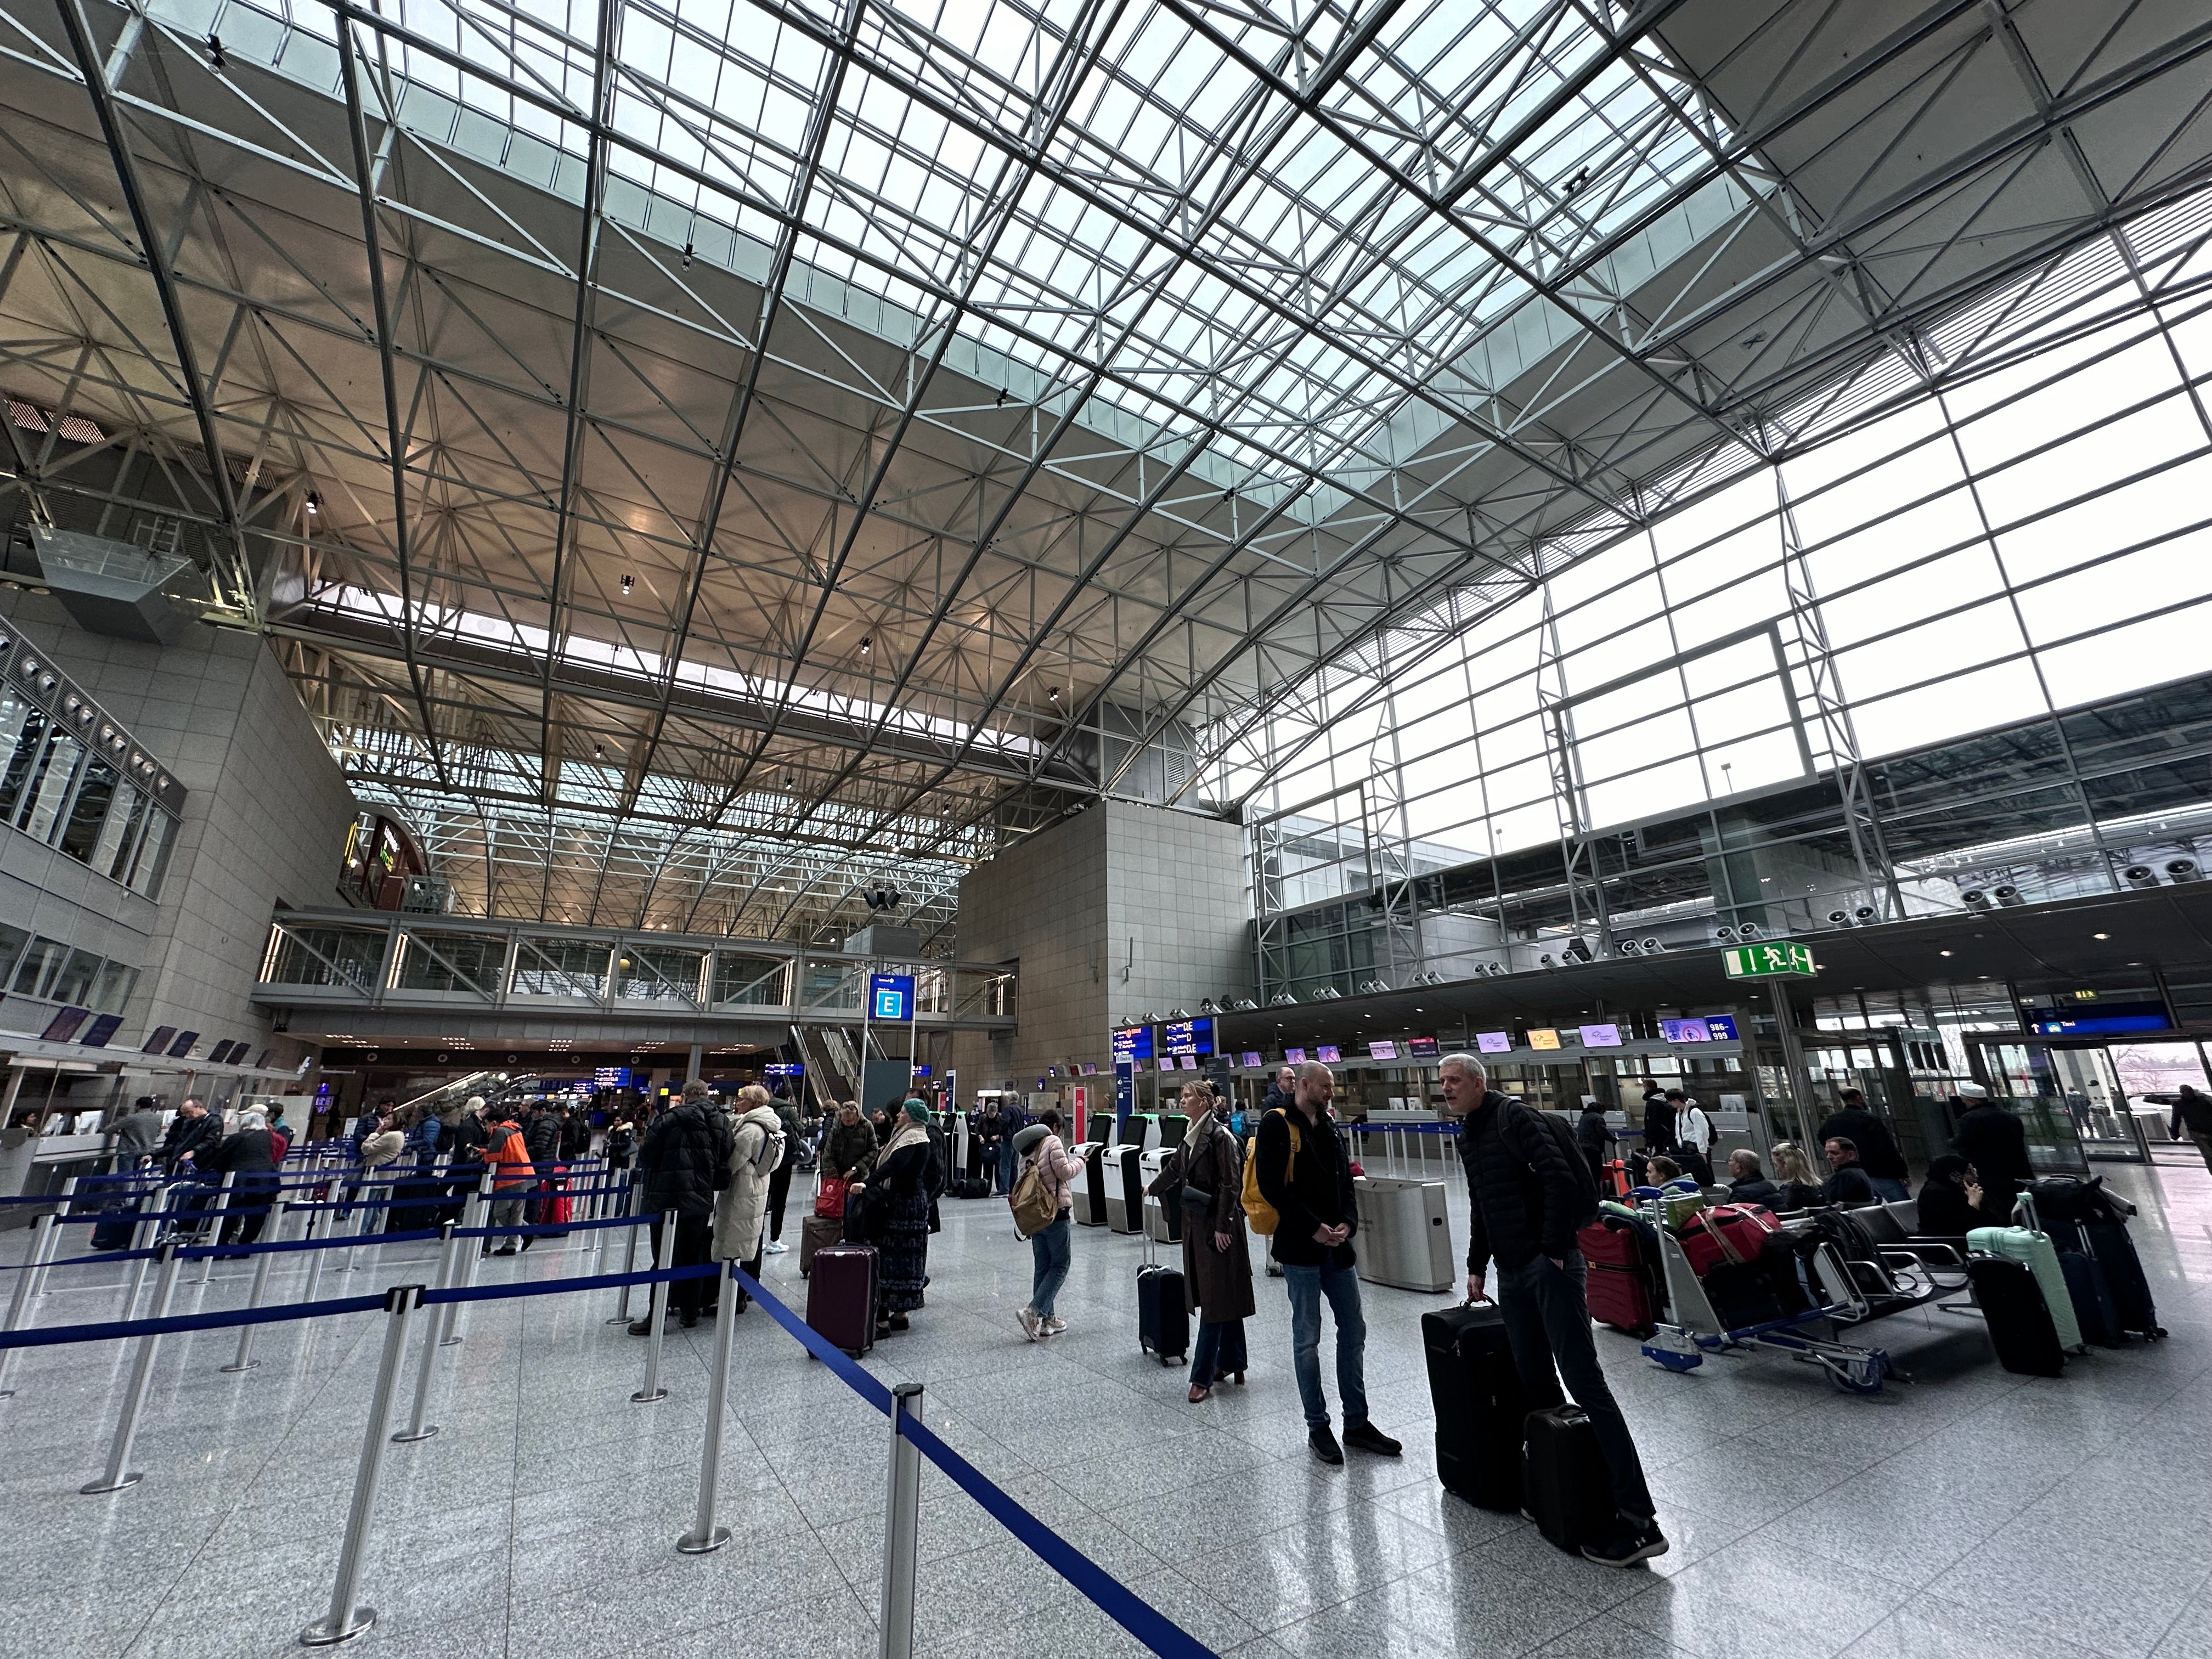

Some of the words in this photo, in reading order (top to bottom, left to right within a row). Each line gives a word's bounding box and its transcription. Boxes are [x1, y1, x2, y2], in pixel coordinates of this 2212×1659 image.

[884, 996, 894, 1012] E
[1709, 1023, 1729, 1032] 986-
[1187, 1032, 1192, 1042] D
[1713, 1032, 1728, 1040] 999
